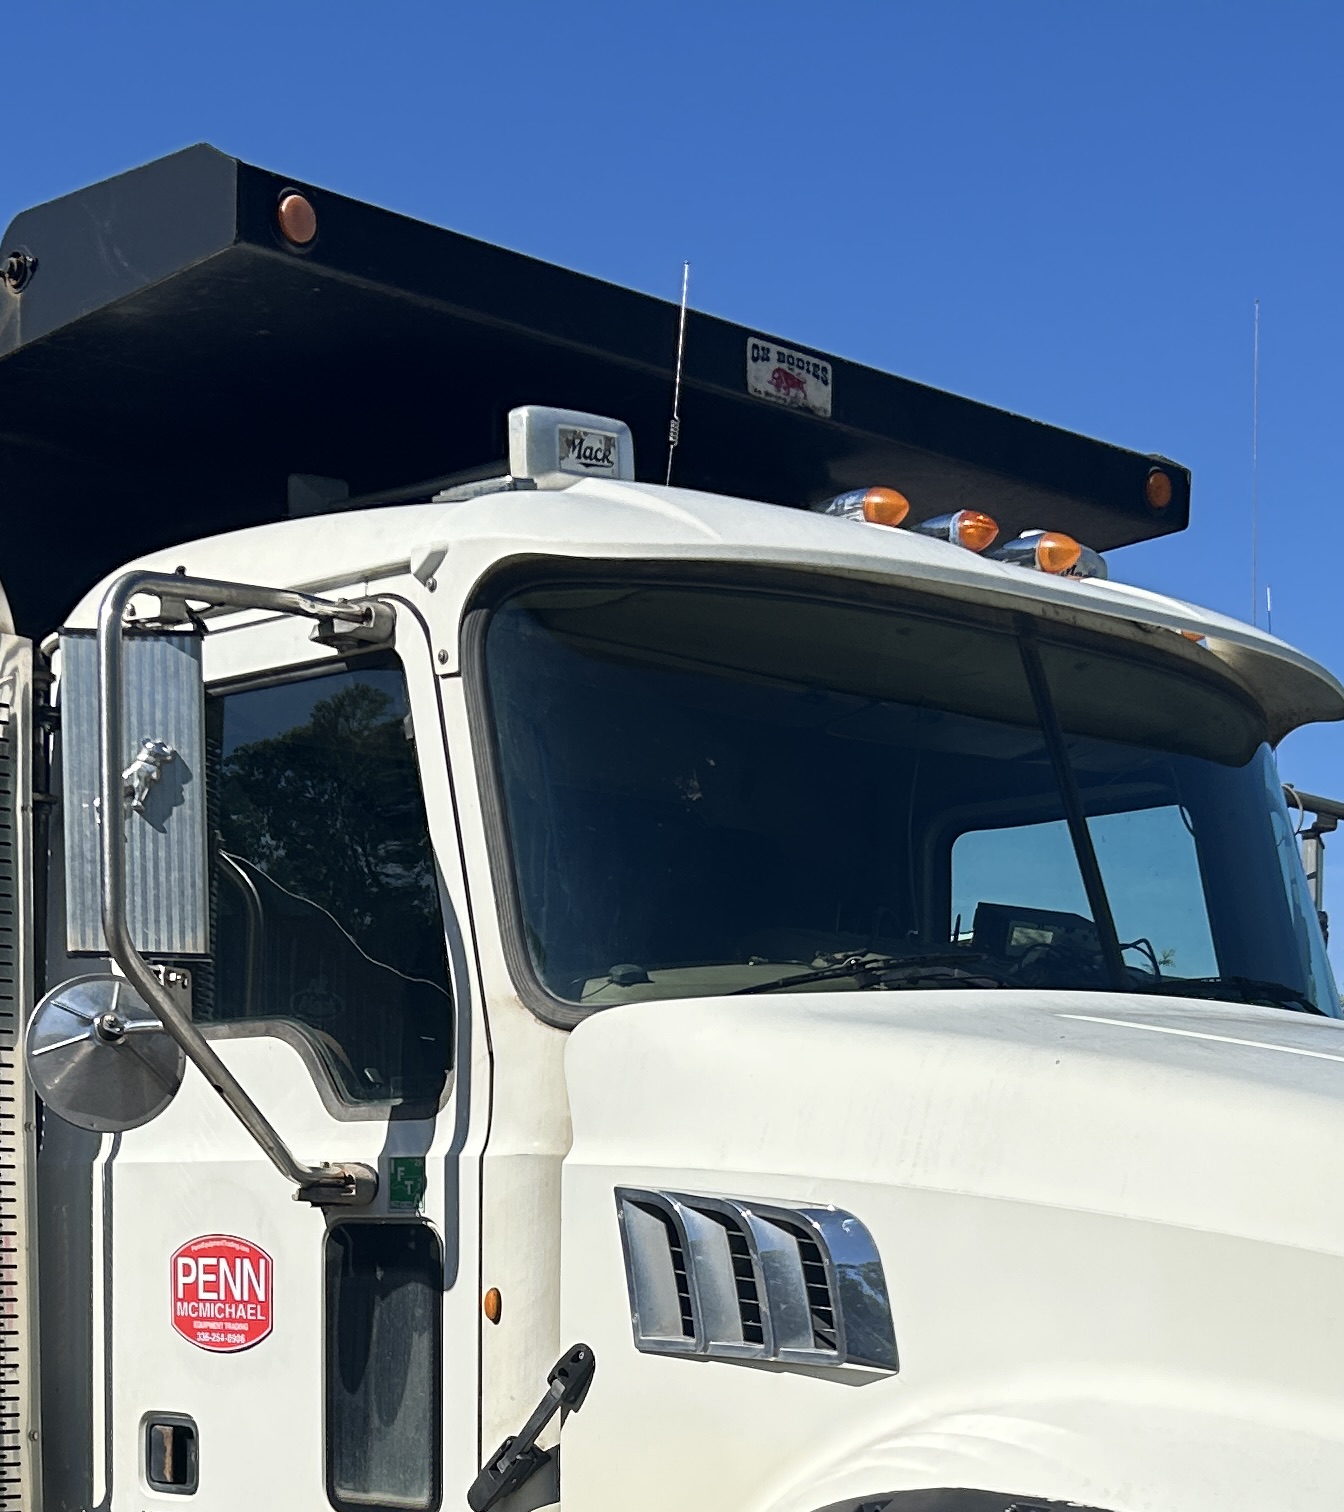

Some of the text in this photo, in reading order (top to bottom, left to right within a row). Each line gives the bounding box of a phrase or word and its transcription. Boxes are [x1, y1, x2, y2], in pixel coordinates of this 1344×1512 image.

[751, 343, 829, 386] OX BODIES
[176, 1256, 266, 1302] PENN
[176, 1301, 266, 1320] MCMICHAEL
